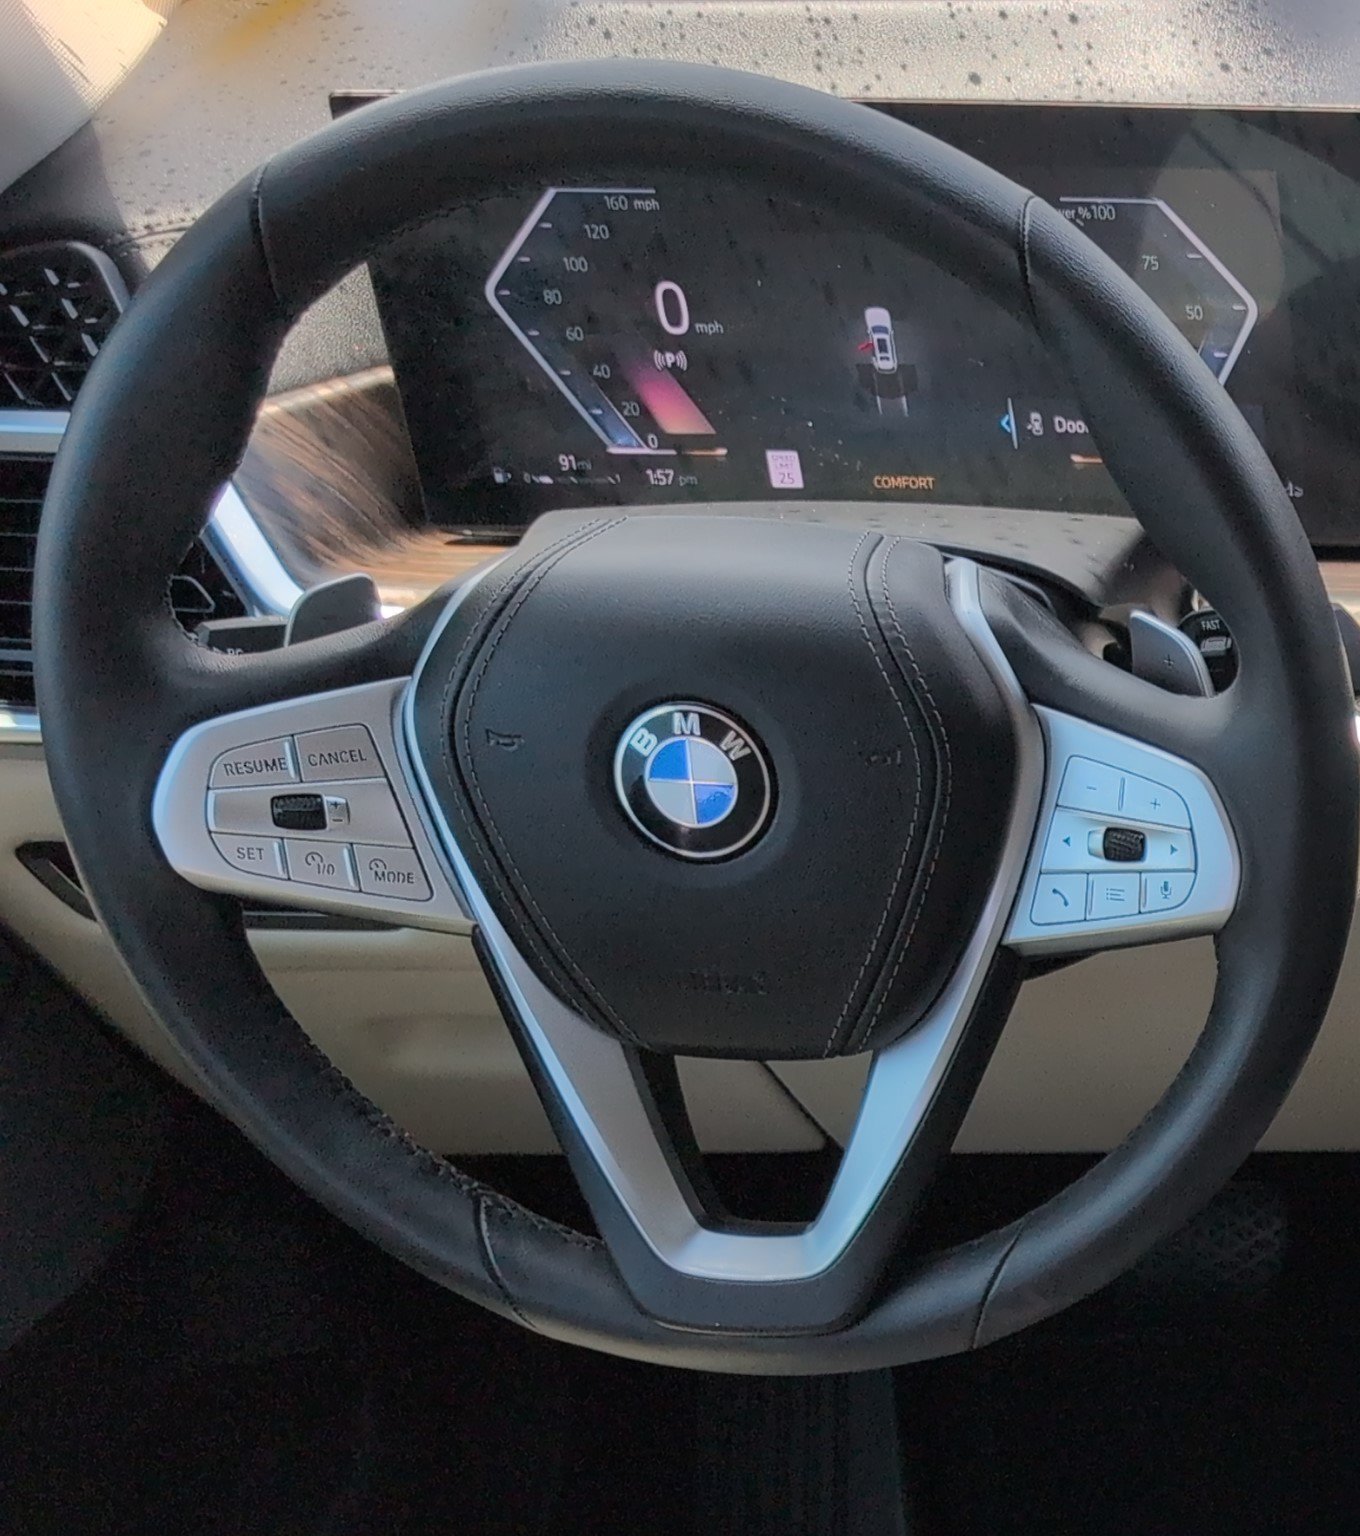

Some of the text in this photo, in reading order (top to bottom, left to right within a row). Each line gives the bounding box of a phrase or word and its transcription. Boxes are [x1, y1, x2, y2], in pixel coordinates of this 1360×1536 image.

[604, 195, 660, 212] 160 mph
[584, 224, 610, 240] 120
[563, 256, 588, 272] 100
[1142, 255, 1159, 271] 75
[543, 289, 562, 305] 80
[654, 280, 724, 336] 0 mph
[1185, 305, 1203, 321] 50
[566, 326, 584, 341] 60
[593, 364, 611, 379] 40
[621, 402, 640, 417] 20
[647, 433, 658, 449] 0
[646, 468, 674, 486] 1:57
[779, 472, 795, 485] 25
[873, 475, 935, 490] COMFORT
[1201, 619, 1221, 631] FAST
[629, 711, 752, 761] BMW
[307, 748, 367, 767] CANCEL
[224, 757, 289, 777] RESUME
[236, 847, 265, 861] SET
[374, 870, 415, 885] MODE
